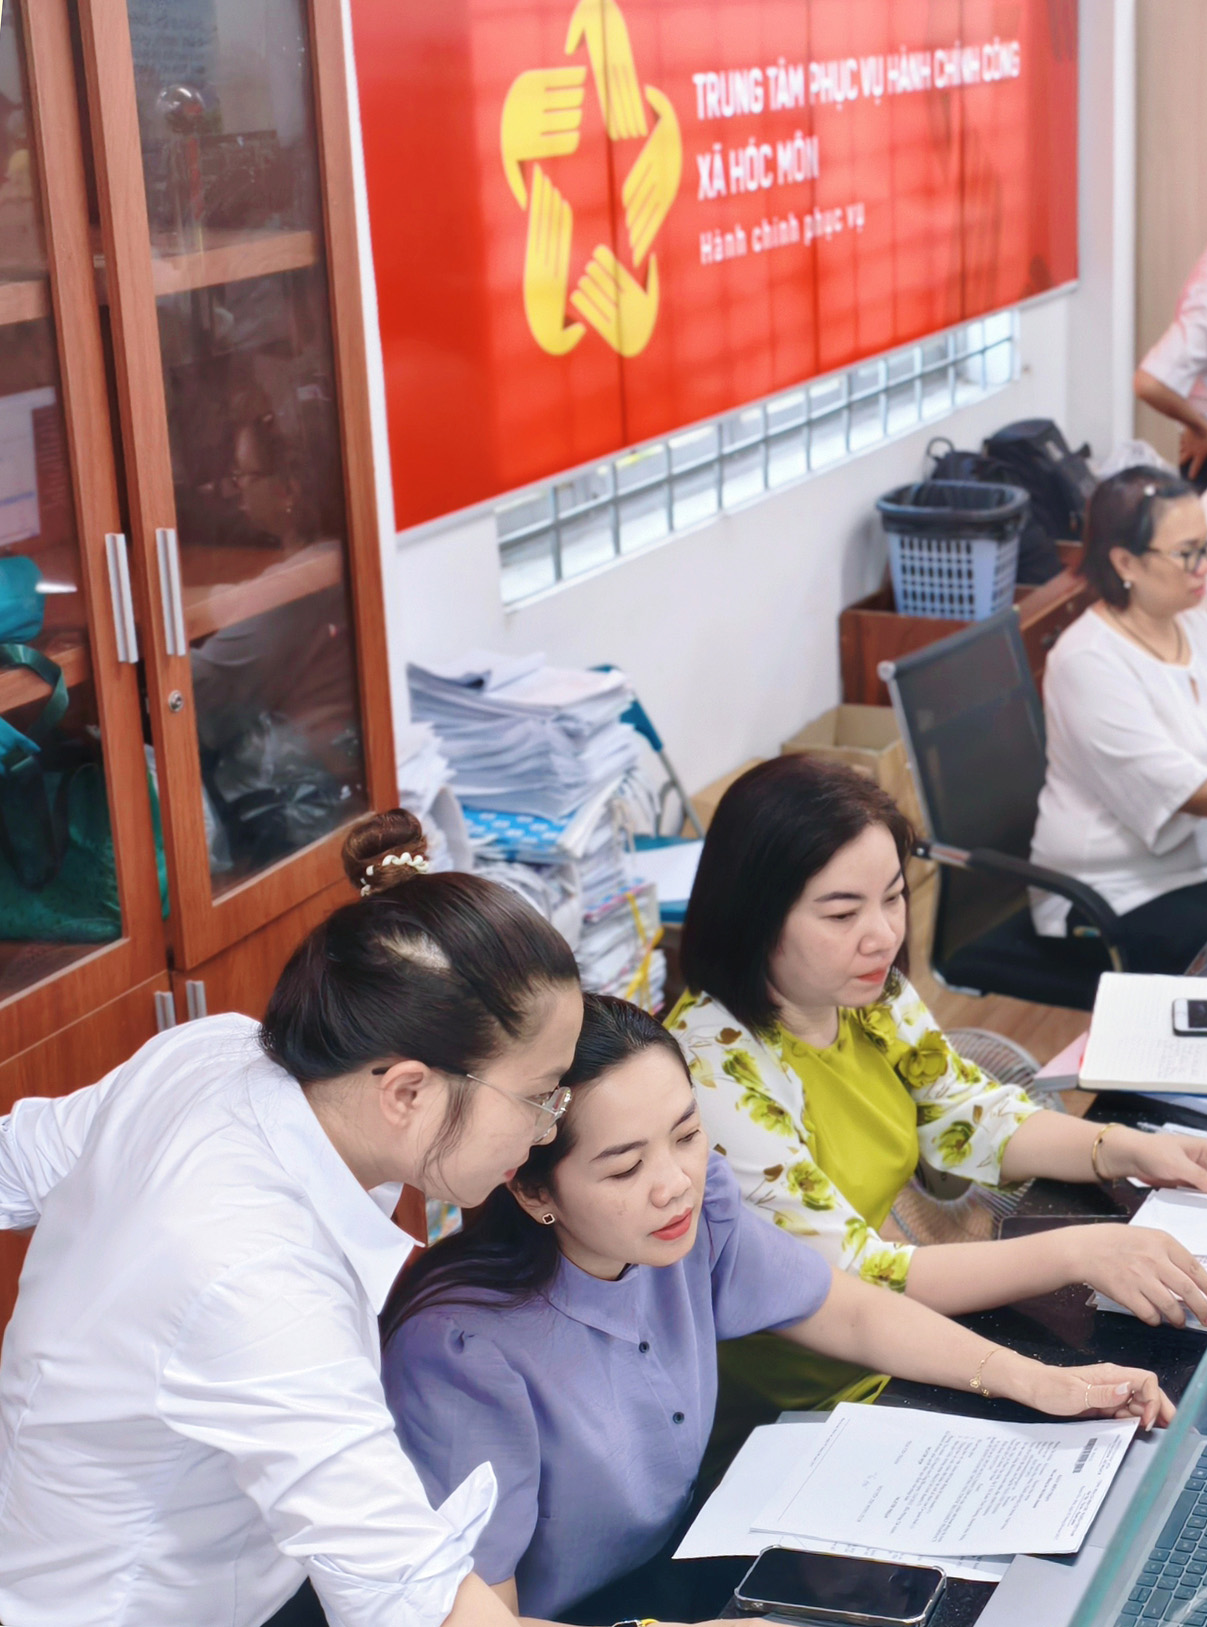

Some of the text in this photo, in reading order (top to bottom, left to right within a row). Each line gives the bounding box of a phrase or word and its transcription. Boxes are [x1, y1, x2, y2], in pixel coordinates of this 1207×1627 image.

[692, 35, 1021, 121] TRUNG TÂM PHỤC VỤ HÀNH CHÍNH CÔNG
[696, 129, 820, 201] XÃ HÓC MÔN
[699, 223, 747, 265] Hành
[803, 207, 843, 247] phục
[845, 202, 866, 233] vụ
